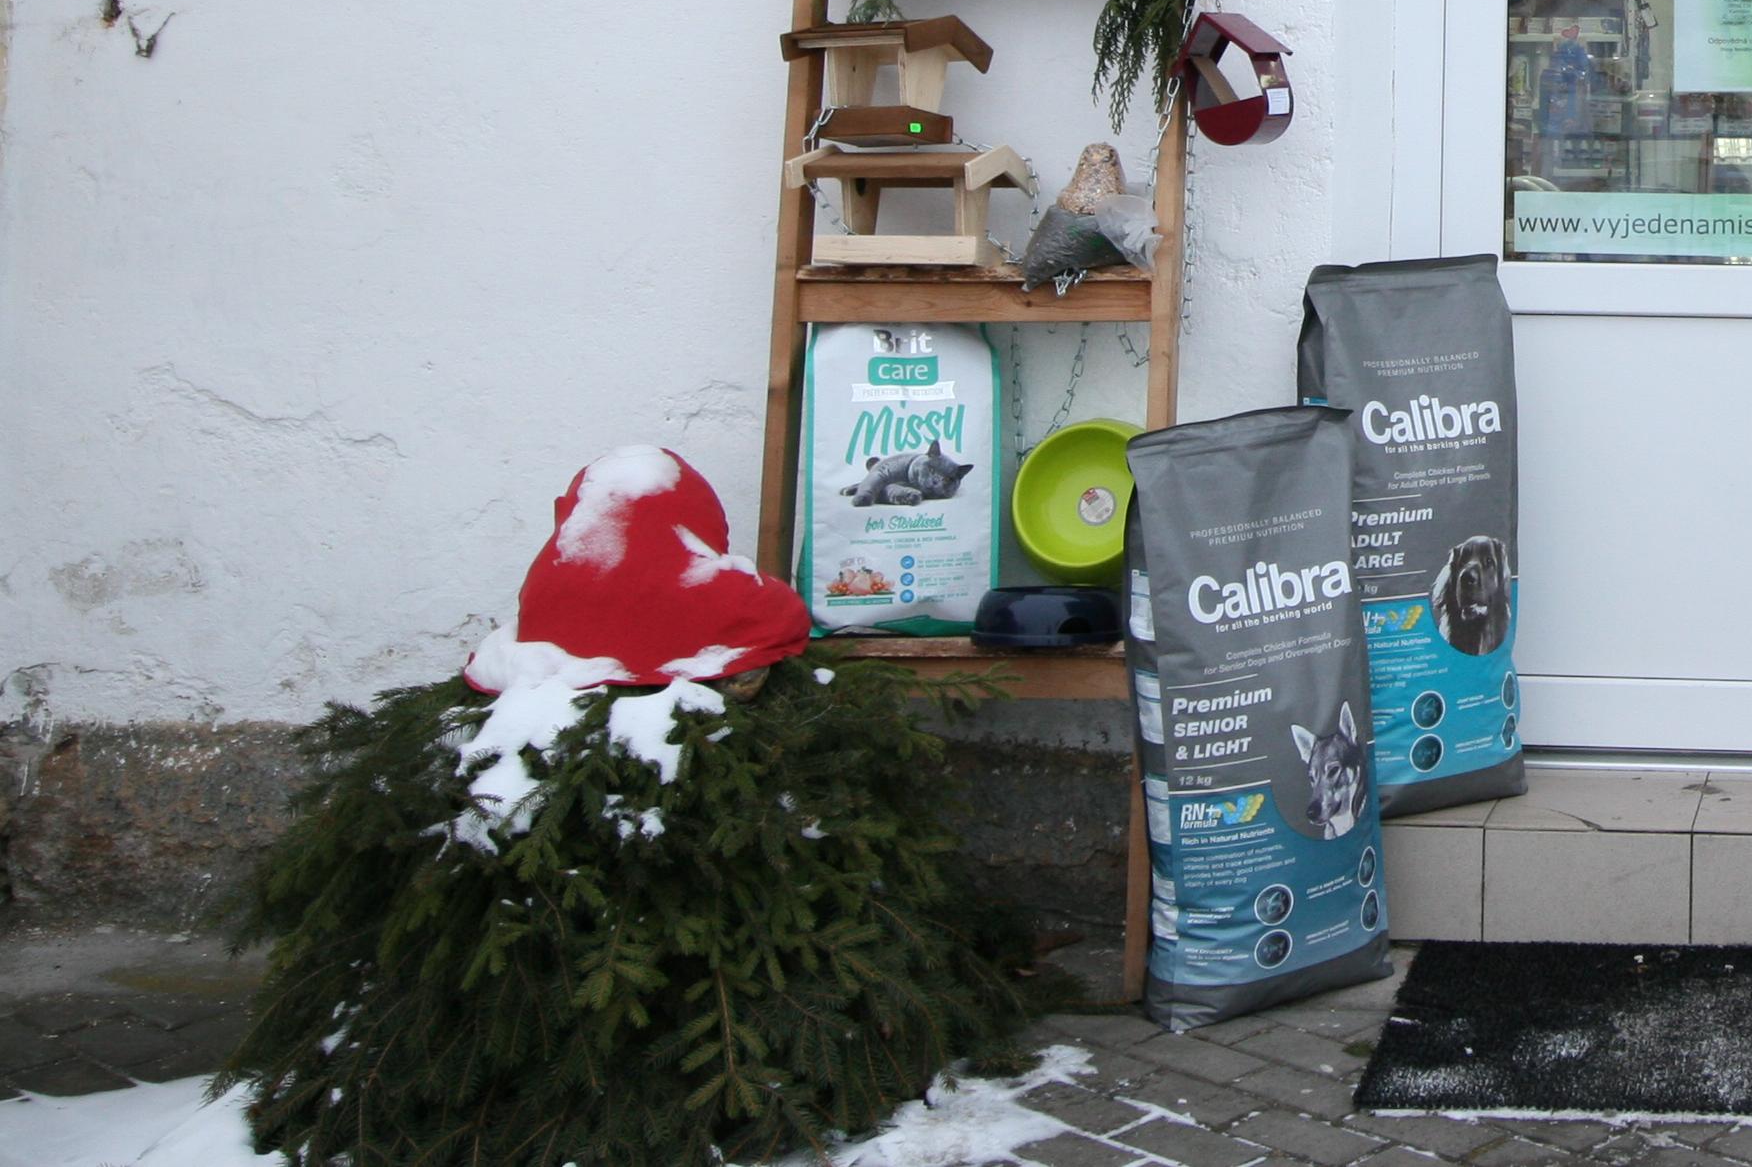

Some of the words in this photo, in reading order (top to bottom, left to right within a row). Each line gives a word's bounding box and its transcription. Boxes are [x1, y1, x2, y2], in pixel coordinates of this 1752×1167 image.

[873, 329, 933, 354] Brit
[878, 363, 929, 381] care
[1363, 357, 1431, 369] PROFESSIONALLY
[1433, 351, 1480, 363] BALANCED
[1377, 367, 1416, 377] PREMIUM
[1417, 362, 1464, 374] NUTRITION
[1362, 394, 1502, 445] Calibra
[1384, 445, 1397, 454] for
[1462, 436, 1487, 447] world
[1189, 518, 1270, 539] PROFESSIONALLY
[1272, 508, 1322, 524] BALANCED
[1208, 531, 1254, 546] PREMIUM
[1256, 522, 1304, 538] NUTRITION
[1353, 552, 1405, 570] ARGE
[1188, 561, 1352, 624] Calibra
[1215, 623, 1229, 633] for
[1232, 620, 1243, 630] all
[1245, 616, 1260, 628] the
[1262, 608, 1301, 624] barking
[1303, 601, 1333, 615] world
[1203, 666, 1217, 676] for
[1218, 661, 1247, 674] Senior
[1247, 656, 1267, 669] Dogs
[1267, 652, 1284, 664] and
[1284, 642, 1333, 661] Overweight
[1172, 687, 1273, 715] Premium
[1173, 715, 1248, 738] SENIOR
[1175, 745, 1188, 761] &
[1193, 736, 1253, 760] LIGHT
[1179, 776, 1195, 787] 12
[1196, 775, 1213, 787] kg
[1181, 836, 1200, 846] Rich
[1200, 835, 1209, 844] in
[1209, 832, 1239, 844] Natural
